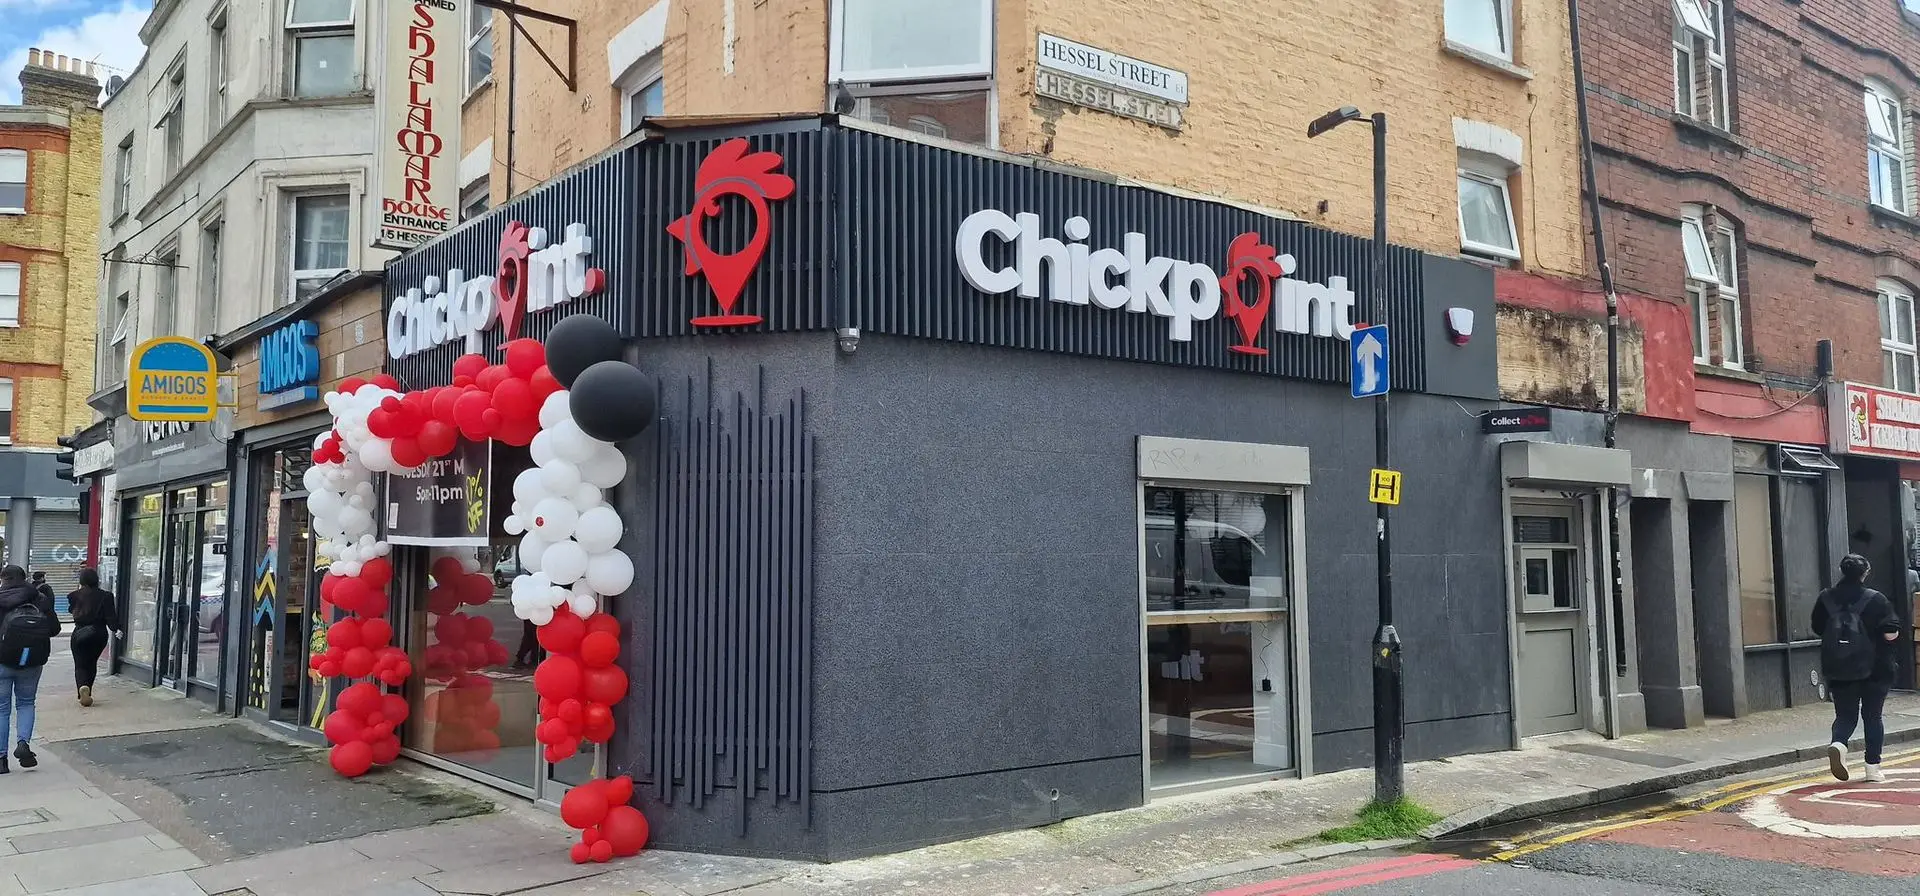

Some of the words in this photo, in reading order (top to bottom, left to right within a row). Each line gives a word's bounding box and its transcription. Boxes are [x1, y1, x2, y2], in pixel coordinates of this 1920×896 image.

[1043, 39, 1105, 73] HESSEL
[1109, 57, 1171, 90] STREET
[397, 4, 442, 204] SHALAMAR
[384, 214, 448, 231] ENTRANCE
[259, 320, 312, 393] AMIGOS
[141, 374, 207, 395] AMIGOS
[1373, 473, 1396, 501] H
